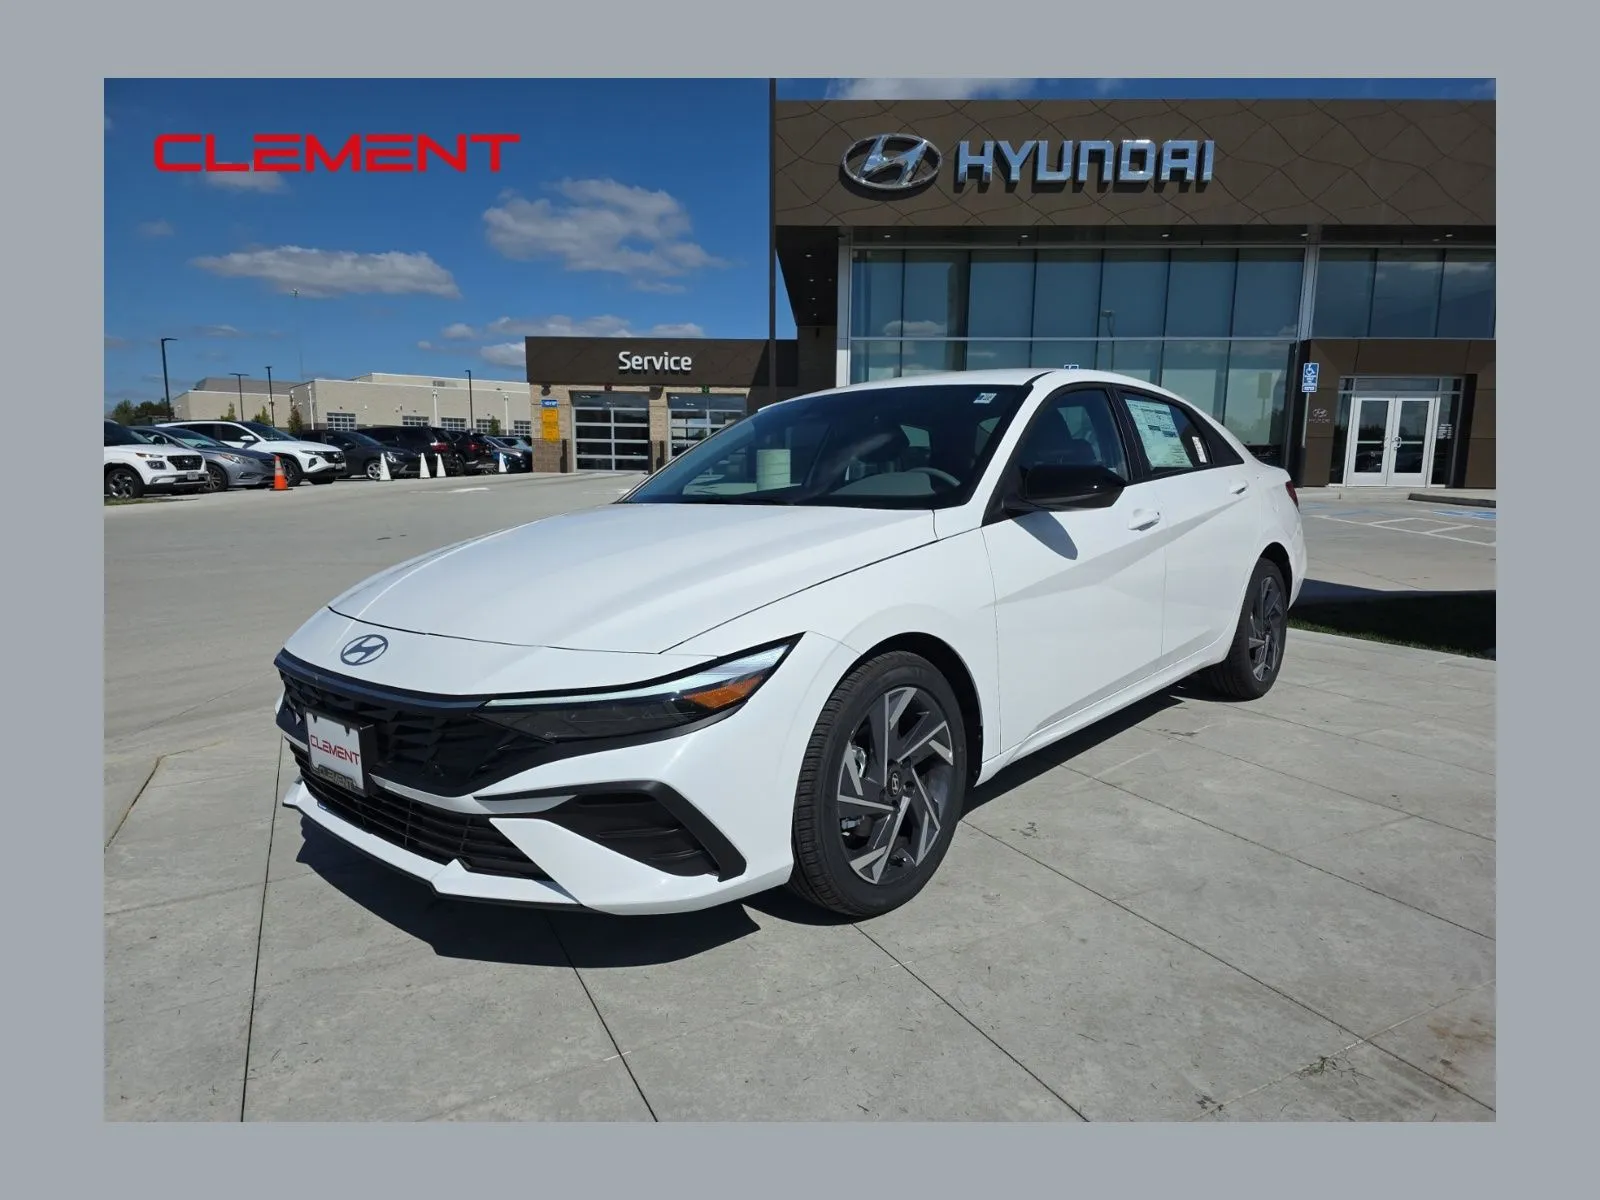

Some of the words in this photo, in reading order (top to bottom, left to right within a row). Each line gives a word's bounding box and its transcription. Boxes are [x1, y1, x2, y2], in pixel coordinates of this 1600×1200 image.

[957, 139, 1215, 184] HYUNDAI
[618, 351, 692, 371] Service
[310, 734, 360, 765] CLEMENT
